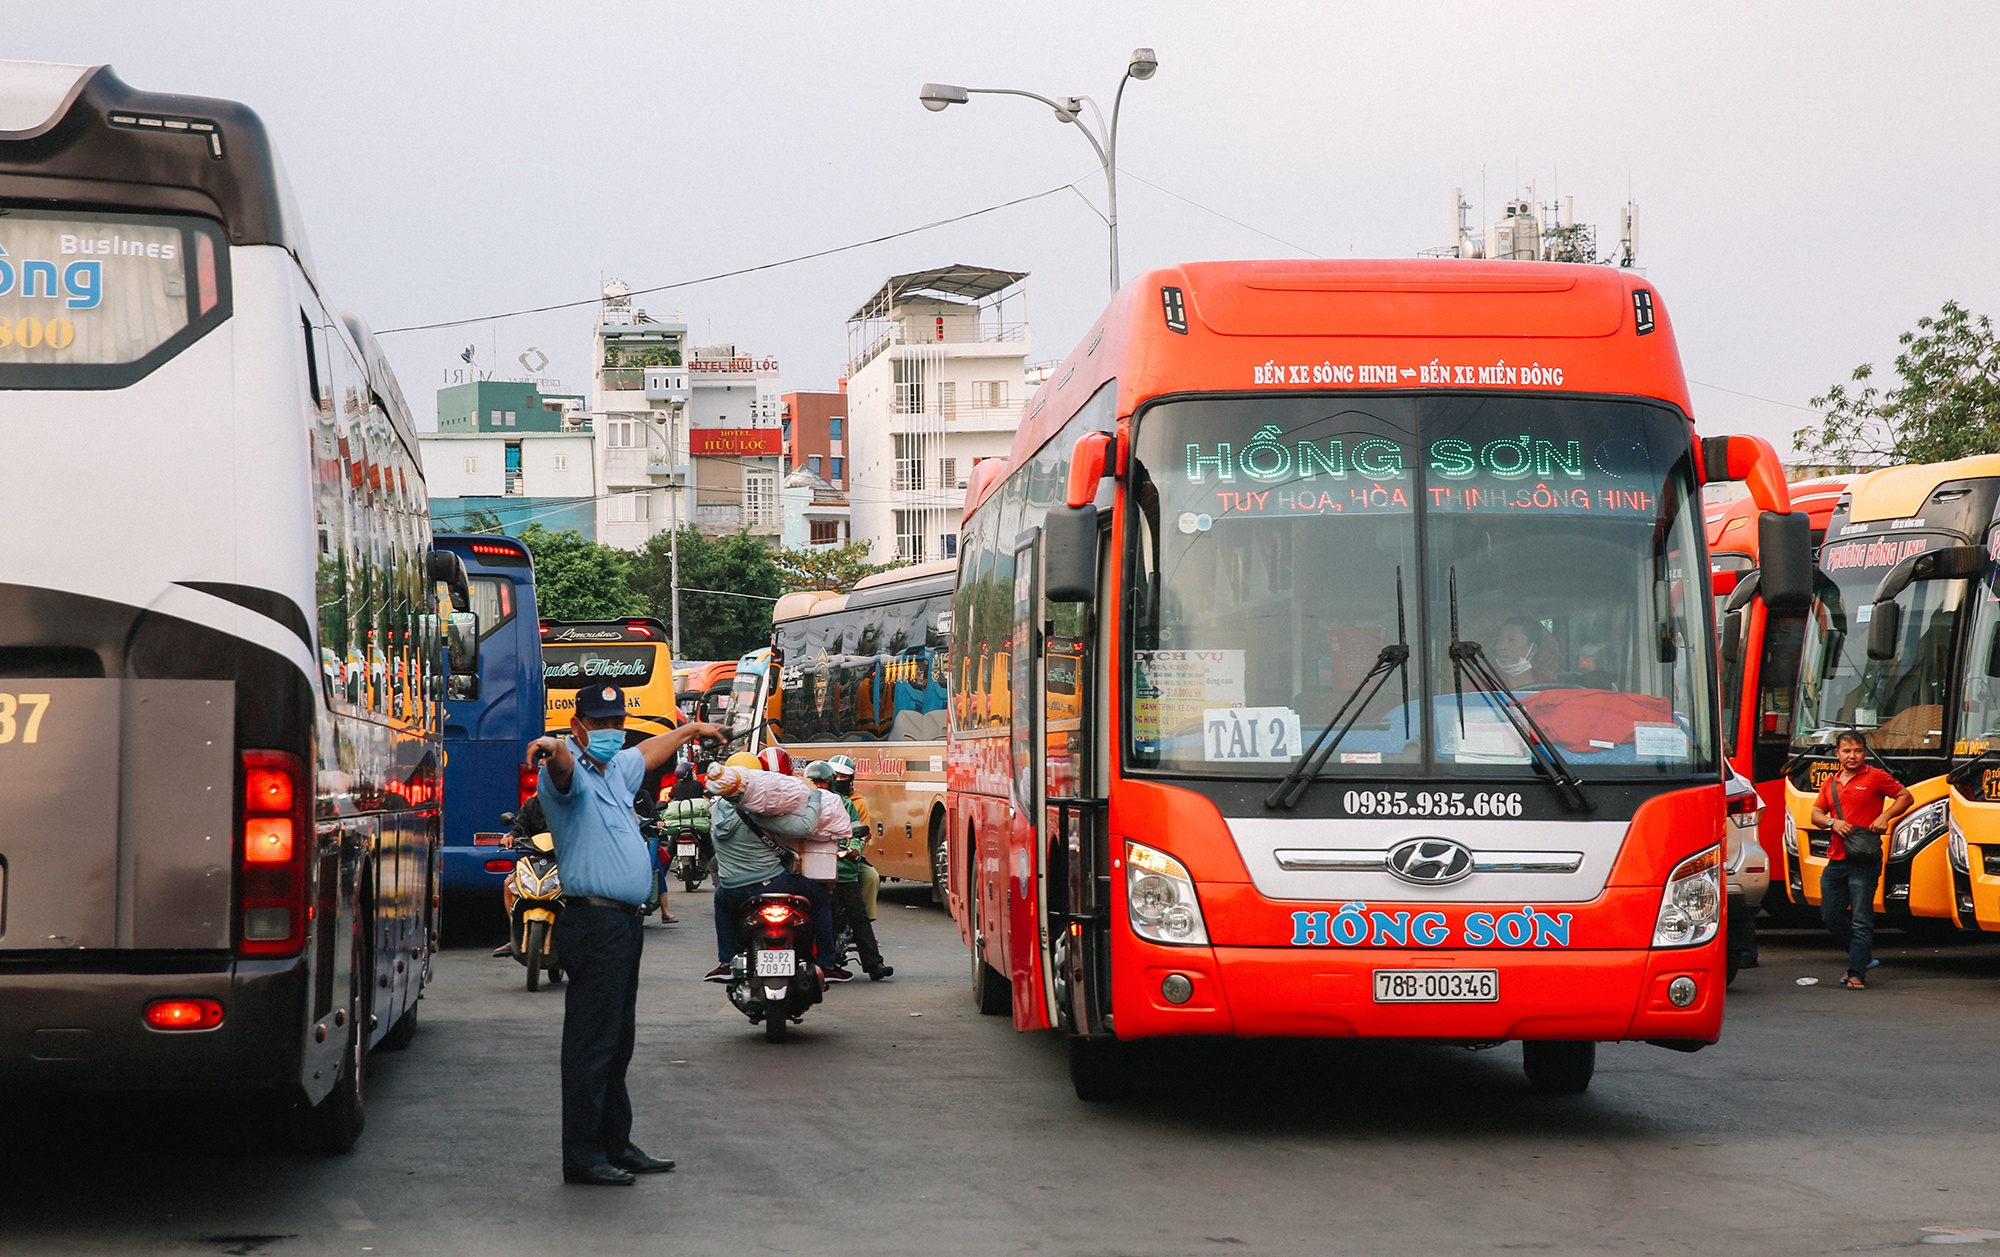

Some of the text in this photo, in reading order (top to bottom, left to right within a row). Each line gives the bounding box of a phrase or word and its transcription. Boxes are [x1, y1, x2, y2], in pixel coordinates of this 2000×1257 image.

[61, 234, 175, 260] Buslines
[688, 361, 724, 370] HOTEL
[1253, 358, 1564, 386] BẾN XE SÔNG HINH BẾN XE MIỀN ĐÔNG
[704, 437, 767, 452] HỮU LỘC
[1185, 424, 1583, 480] HỒNG SƠN
[1216, 490, 1270, 512] TUY
[1864, 535, 1898, 570] HỒNG
[554, 628, 622, 641] Limousine
[584, 658, 647, 678] Thịnh
[1207, 710, 1288, 758] TÀI 2
[1343, 790, 1523, 817] 0935.935.666
[1291, 900, 1574, 947] HỒNG SƠN
